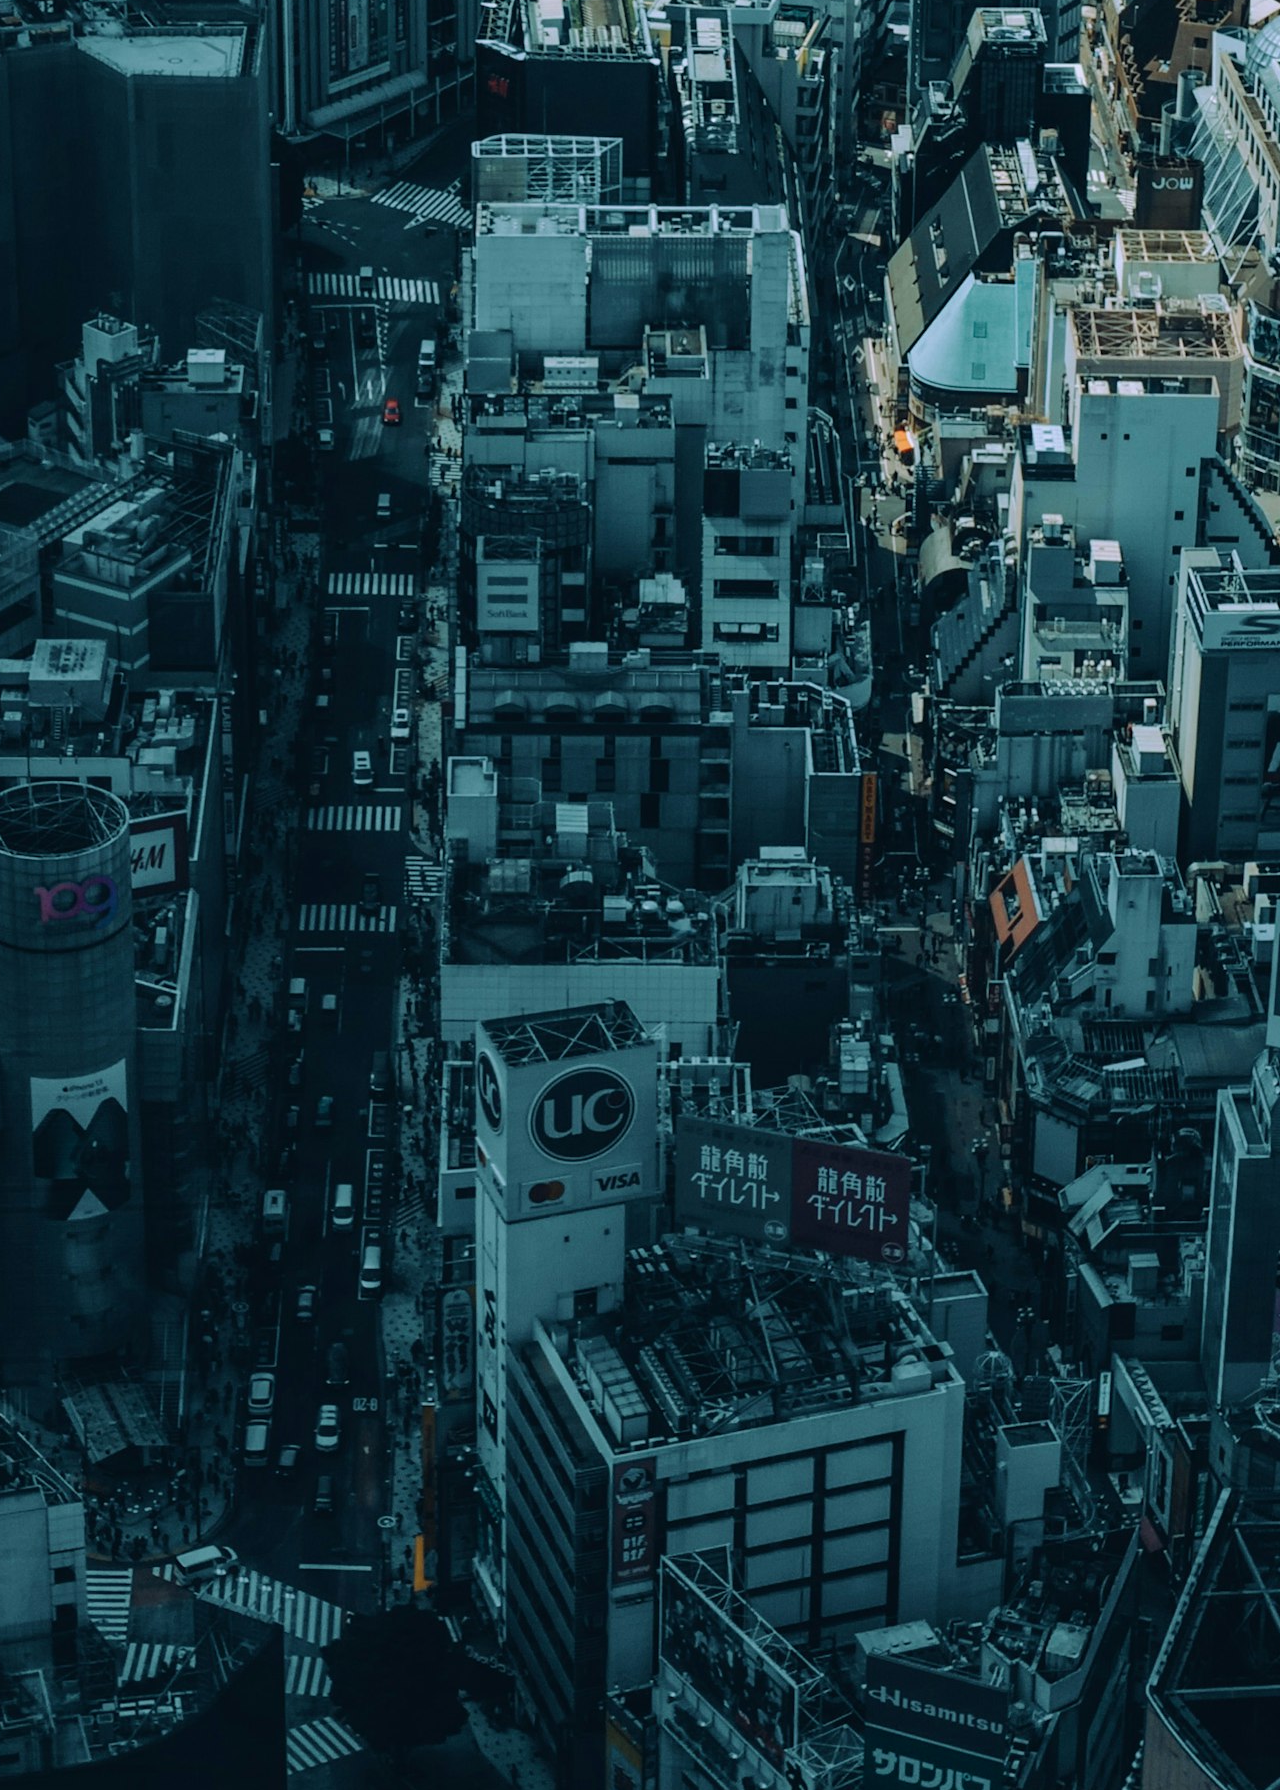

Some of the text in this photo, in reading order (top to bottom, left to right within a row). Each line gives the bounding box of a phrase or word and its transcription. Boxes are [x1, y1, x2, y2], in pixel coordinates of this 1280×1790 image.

[1152, 177, 1194, 190] JOW
[34, 877, 118, 931] 109
[699, 1144, 769, 1180] 龍角散
[595, 1172, 642, 1193] VISA
[817, 1166, 887, 1204] 龍角散
[869, 1685, 1004, 1736] Hisamitsu
